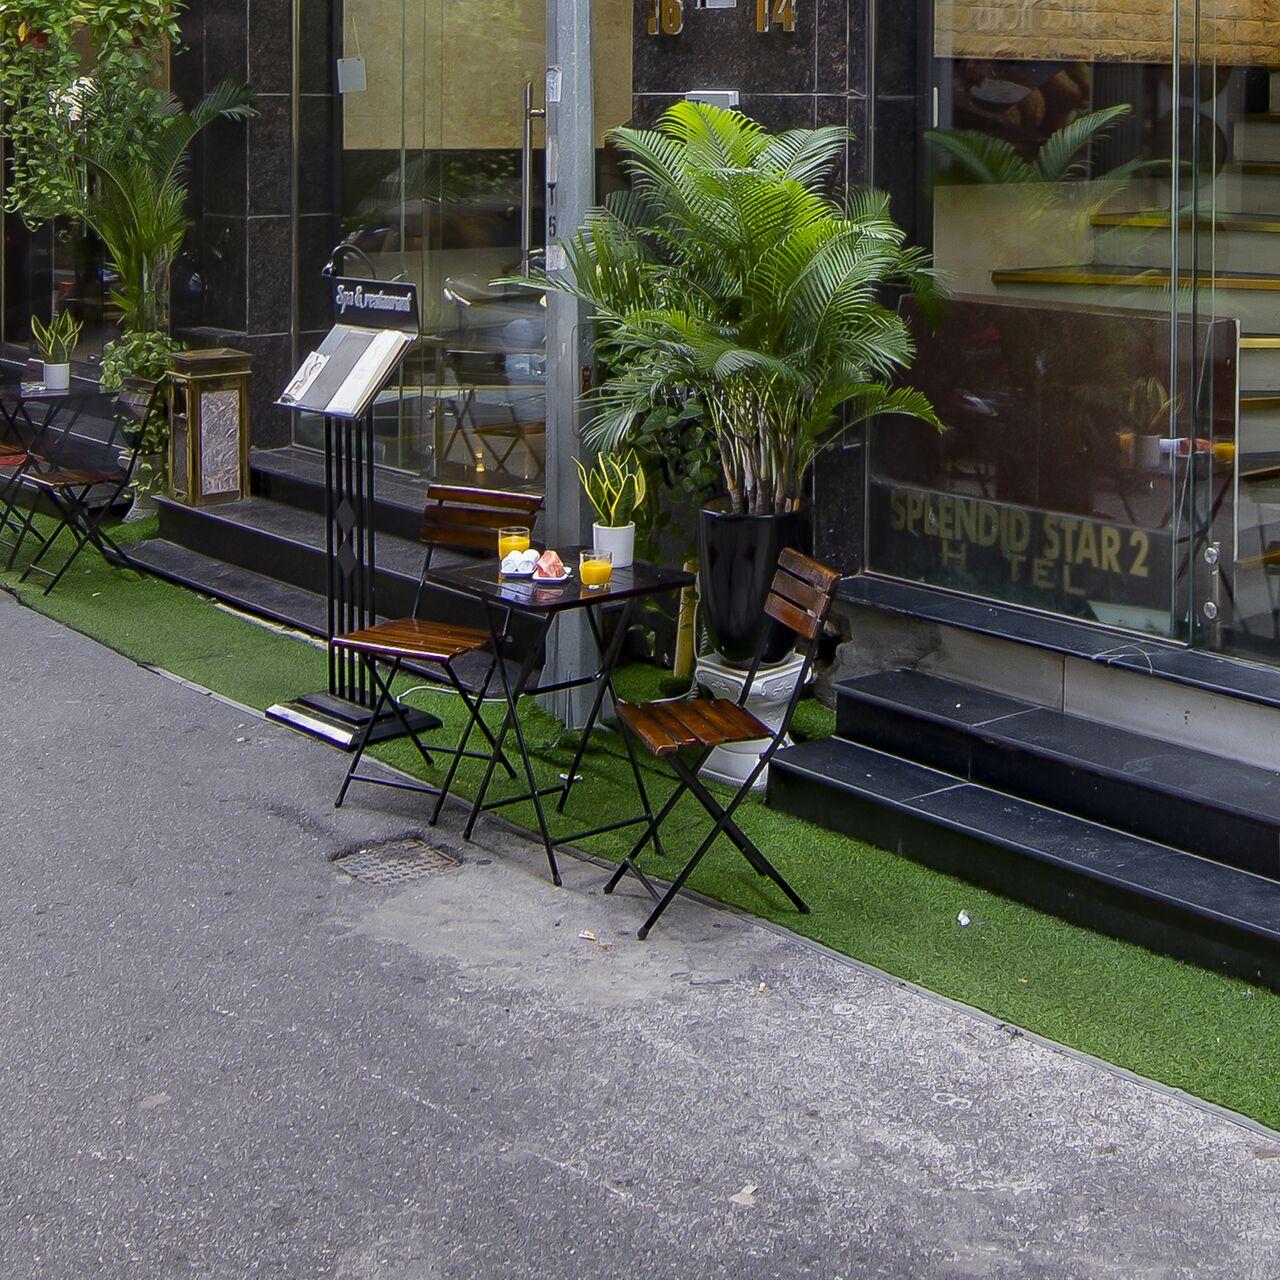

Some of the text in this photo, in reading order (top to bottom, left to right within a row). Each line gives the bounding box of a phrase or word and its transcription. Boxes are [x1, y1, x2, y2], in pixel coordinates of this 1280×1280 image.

[889, 487, 1150, 578] SPLENDID STAR 2
